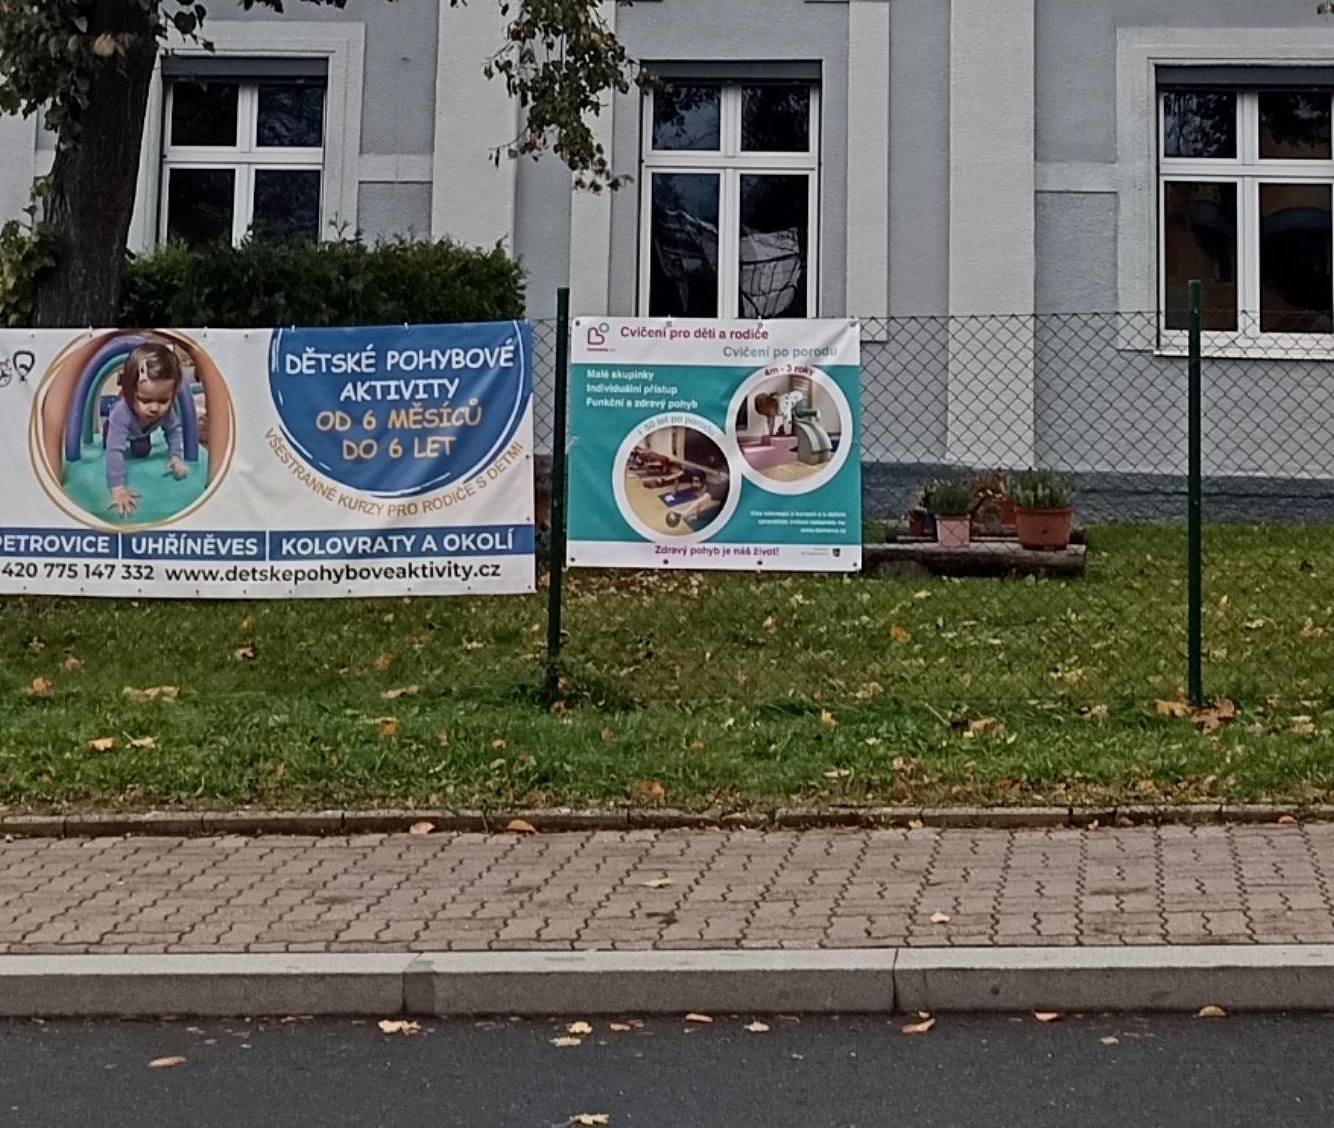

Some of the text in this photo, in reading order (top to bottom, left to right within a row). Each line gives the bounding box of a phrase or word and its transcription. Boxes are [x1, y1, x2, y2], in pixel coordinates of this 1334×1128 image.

[620, 326, 769, 341] Cvičení pro děti a rodiče
[285, 338, 515, 374] DĚTSKÉ POHYBOVÉ
[723, 345, 838, 360] Cvičení po porodu
[587, 368, 655, 382] Malé skupinky
[339, 377, 460, 402] AKTIVITY
[586, 383, 679, 396] Individuální přístup
[316, 397, 483, 432] OD 6 MĚSÍCŮ
[586, 397, 699, 411] Funkční a zdravý pohyb
[342, 435, 457, 460] DO 6 LET
[265, 428, 525, 517] VŠESTRANNÉ KURZY PRO RODIČE S DĚTMI
[131, 534, 258, 556] UHŘÍNĚVES
[281, 528, 515, 556] KOLOVRATY A OKOLÍ
[655, 544, 687, 557] Zdravý
[690, 545, 720, 557] pohyb
[722, 547, 732, 557] je
[733, 546, 751, 556] náš
[44, 563, 79, 579] 775
[83, 563, 116, 580] 147
[121, 564, 154, 581] 332
[165, 561, 502, 585] www.detskepohyboveaktivity.cz
